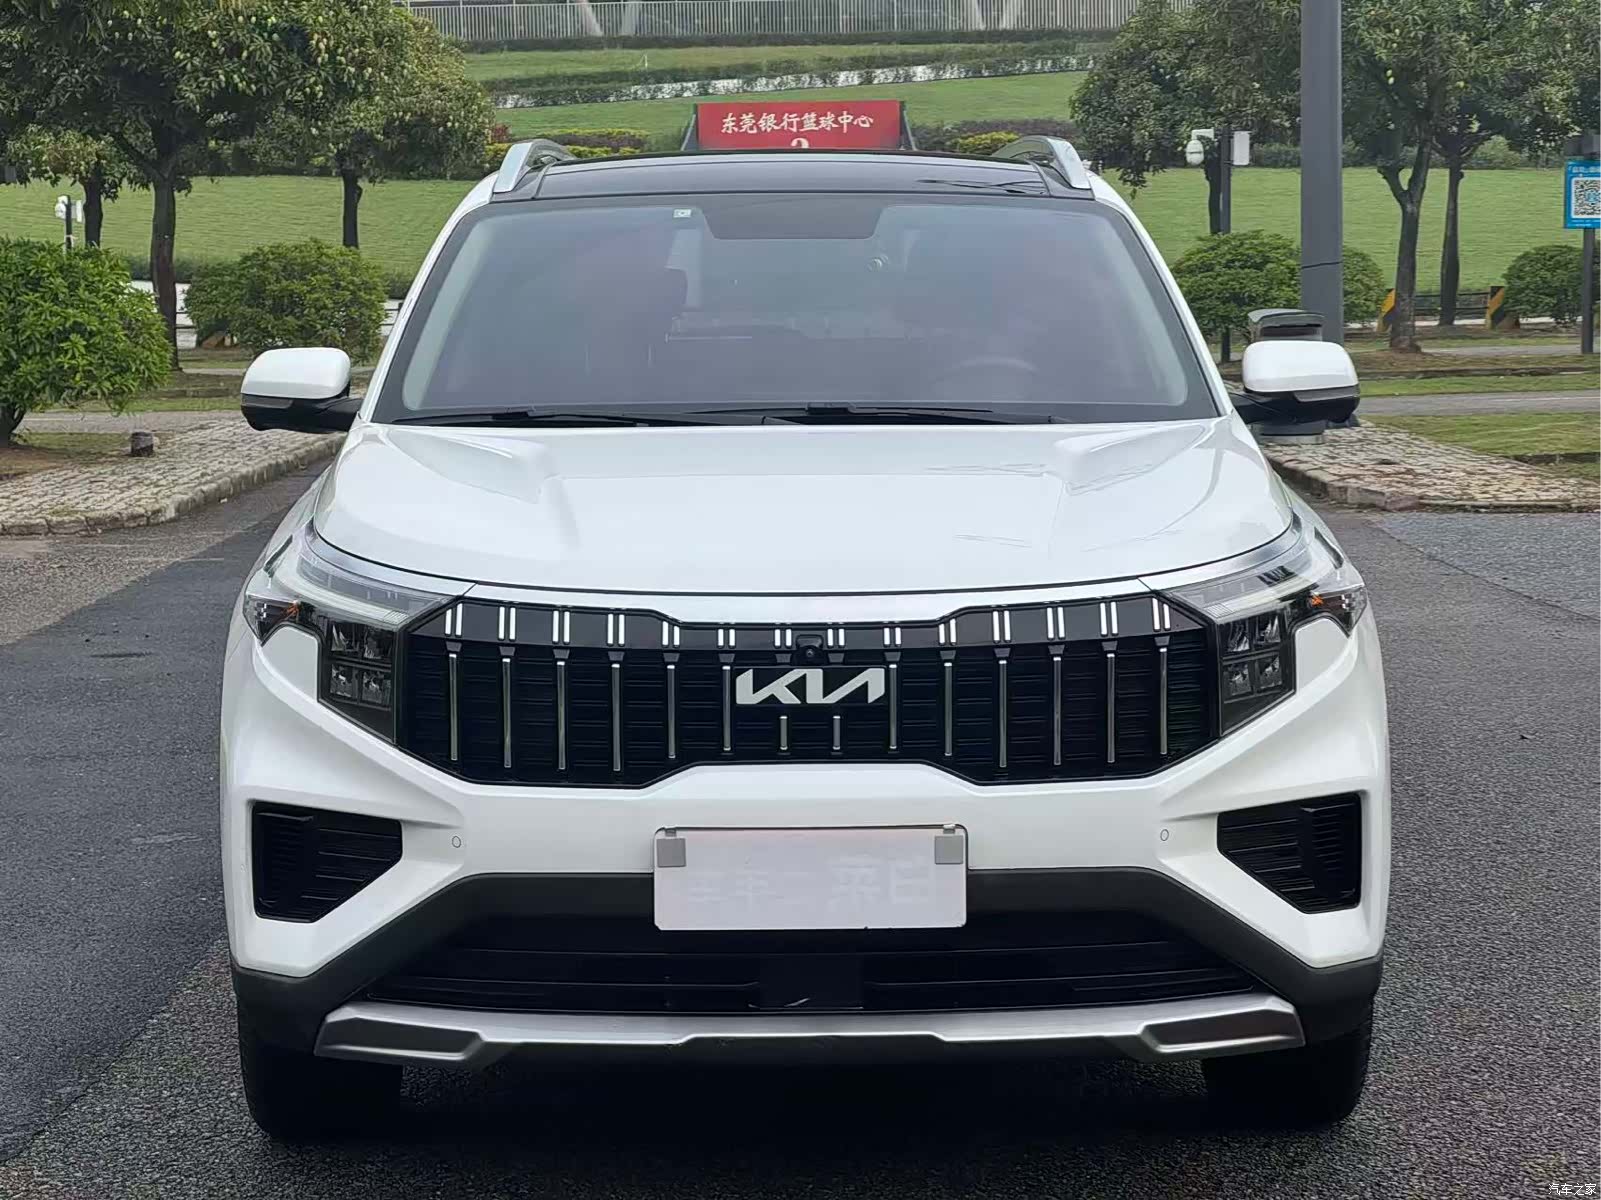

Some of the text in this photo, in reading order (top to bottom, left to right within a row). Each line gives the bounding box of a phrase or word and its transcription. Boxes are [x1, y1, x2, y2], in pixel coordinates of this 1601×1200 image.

[721, 111, 874, 134] 东莞银行篮球中心
[736, 668, 886, 704] KIA
